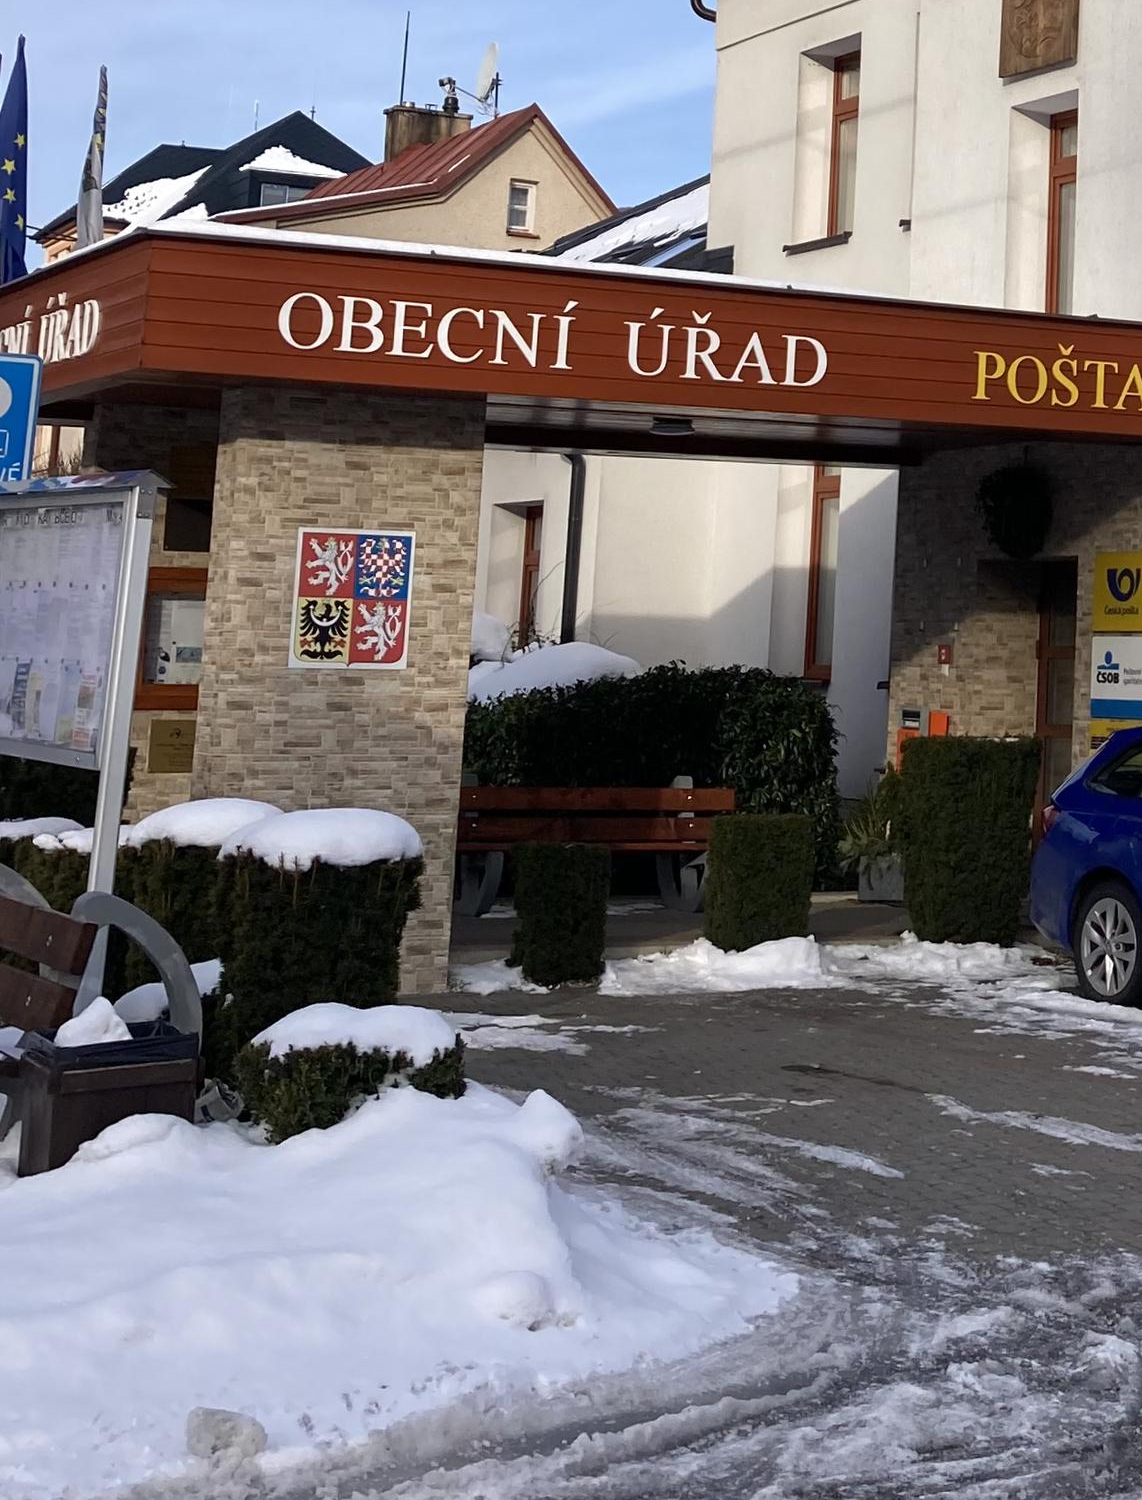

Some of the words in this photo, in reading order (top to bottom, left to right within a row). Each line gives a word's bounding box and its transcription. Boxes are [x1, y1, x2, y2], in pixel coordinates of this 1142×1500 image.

[39, 292, 101, 365] ÚŘAD
[277, 291, 580, 370] OBECNÍ
[623, 307, 829, 387] ÚŘAD
[1096, 671, 1120, 684] ČSOB
